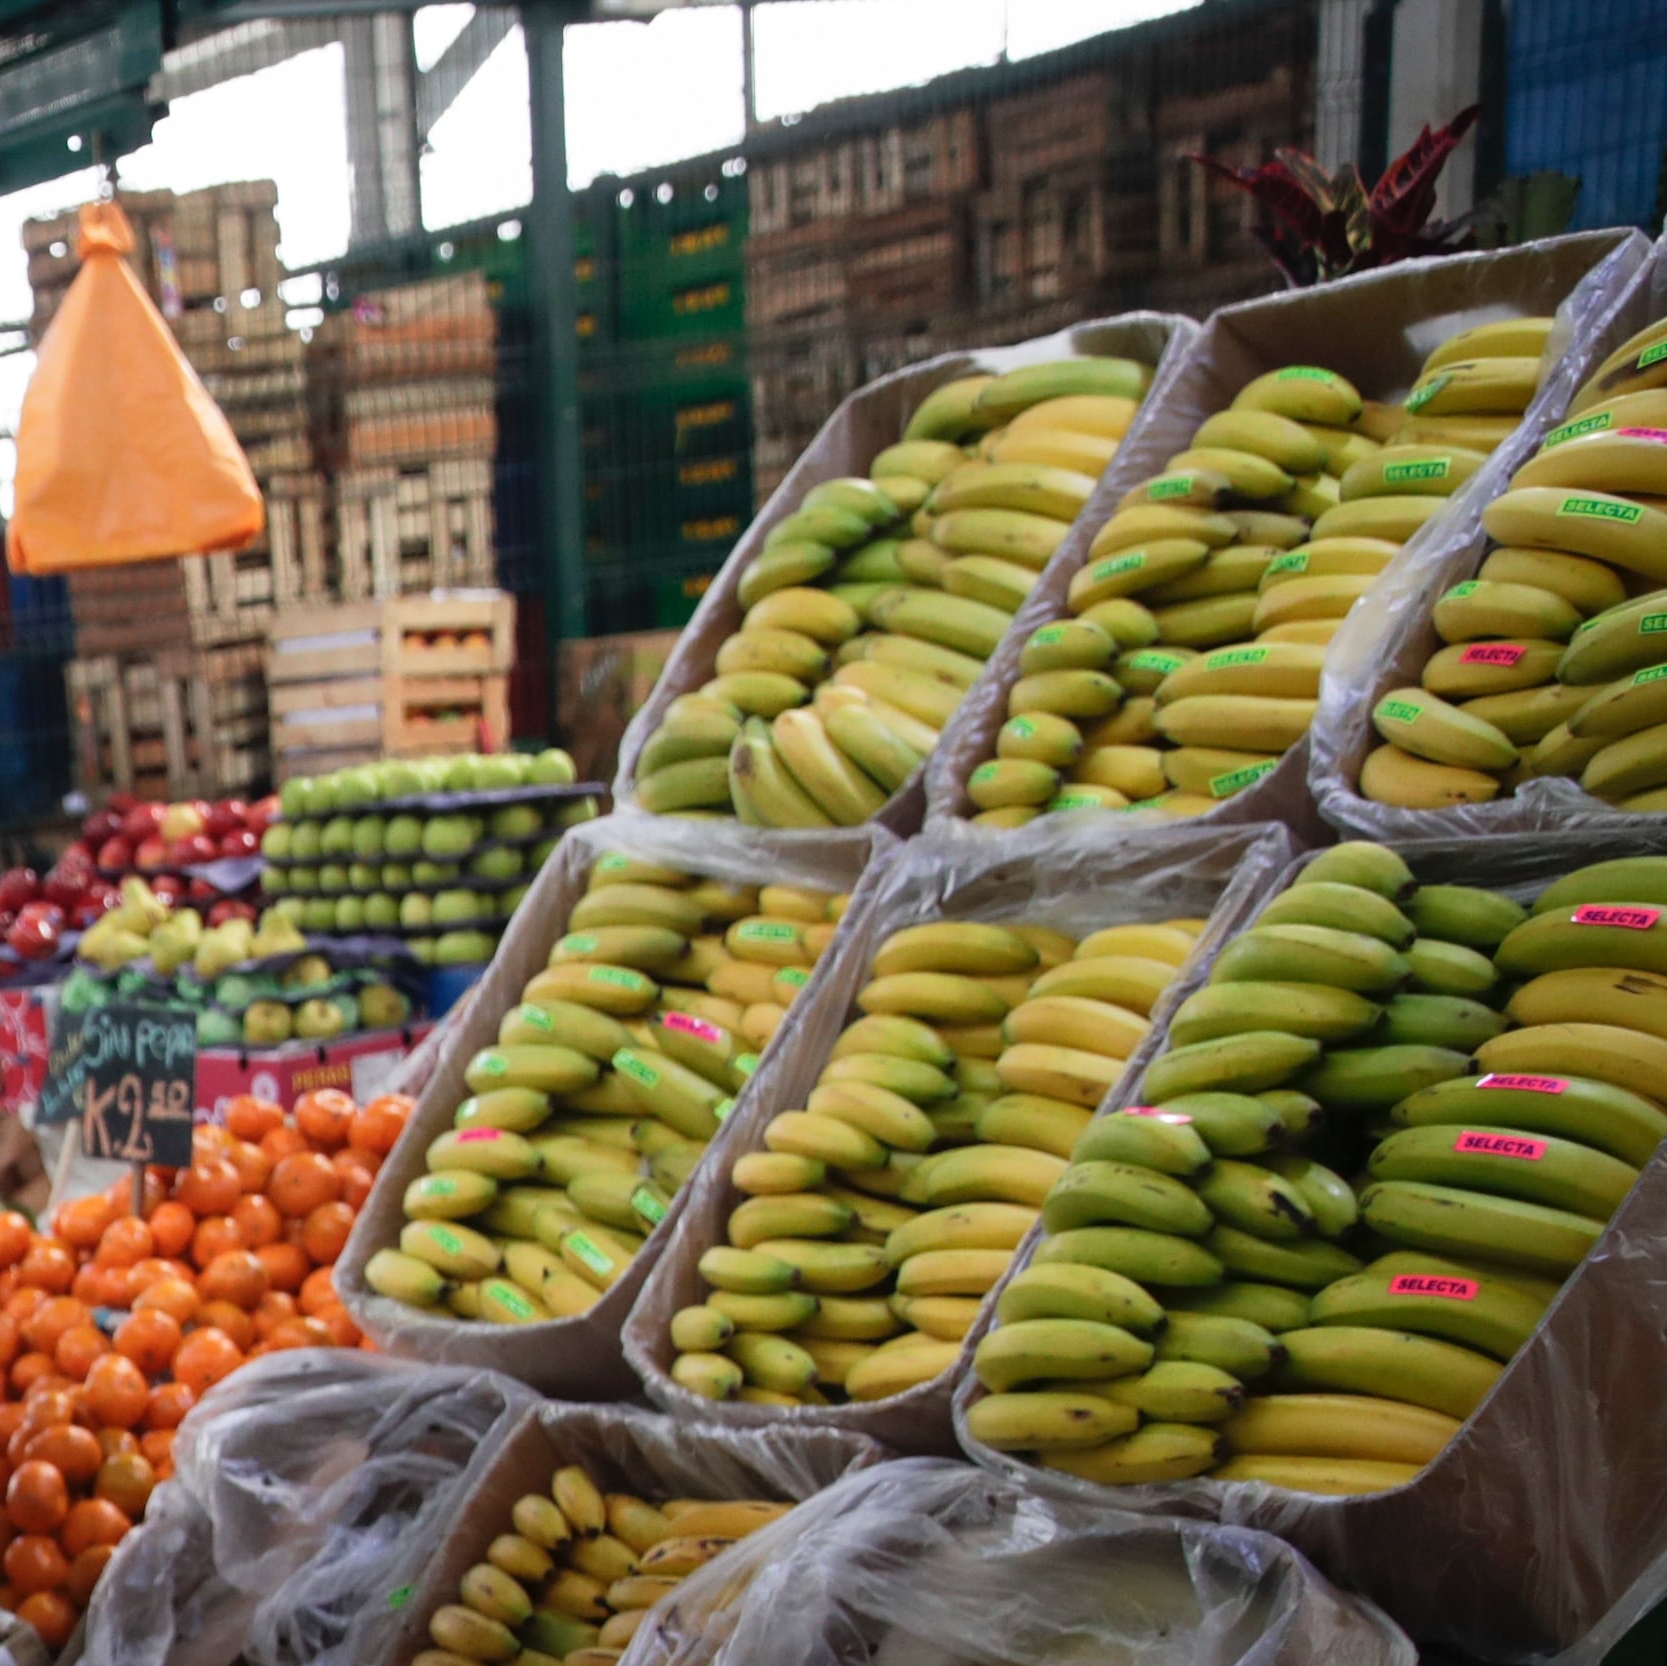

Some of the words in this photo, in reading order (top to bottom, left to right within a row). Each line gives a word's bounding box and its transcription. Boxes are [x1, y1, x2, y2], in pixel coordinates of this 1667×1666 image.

[1548, 416, 1610, 446] SELECTA
[1386, 462, 1446, 480] SELECTA
[1565, 500, 1637, 521] SELECTA
[1466, 648, 1520, 663] SELECTA
[1581, 909, 1649, 927] SELECTA
[1463, 1135, 1535, 1156] SELECTA
[1397, 1277, 1468, 1295] SELECTA
